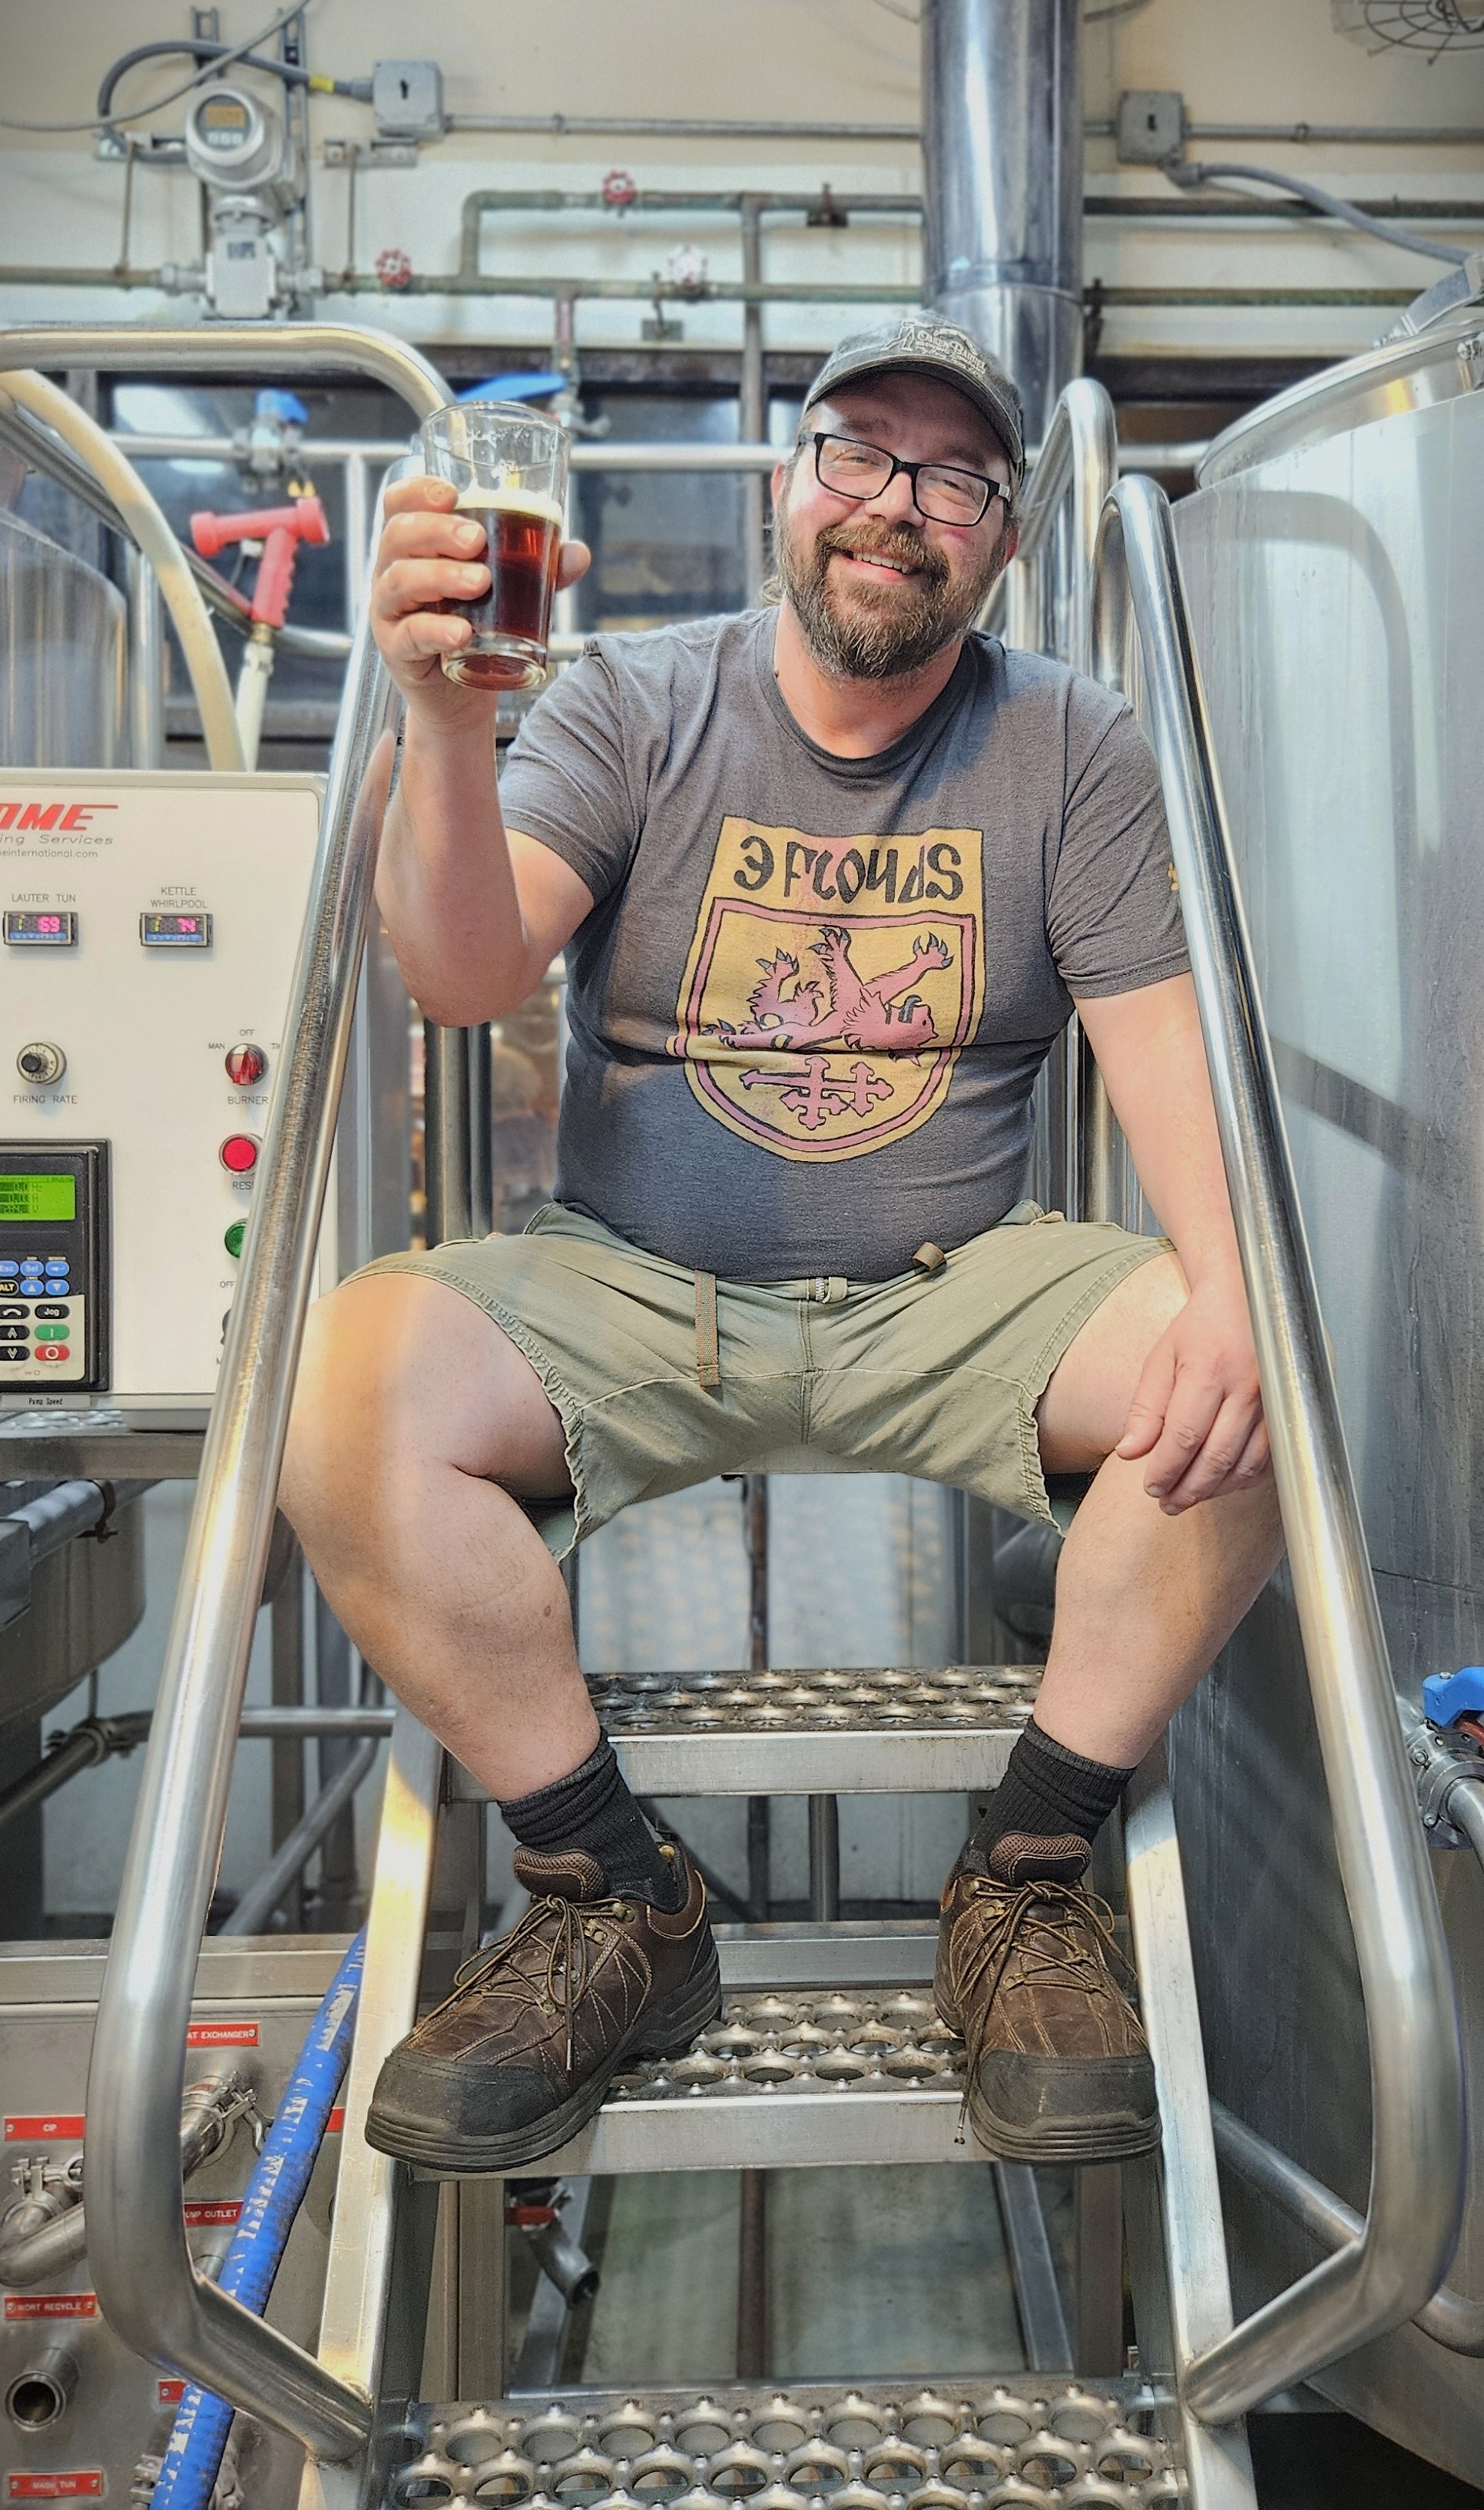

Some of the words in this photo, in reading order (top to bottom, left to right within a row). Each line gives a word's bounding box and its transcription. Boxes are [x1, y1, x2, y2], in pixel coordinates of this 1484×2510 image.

[38, 834, 114, 845] Services
[161, 887, 197, 897] KETTLE
[12, 894, 50, 904] LAUTER
[56, 894, 76, 904] TUN
[151, 899, 208, 909] WHIRLPOOL
[239, 1029, 256, 1037] OFF
[13, 1095, 47, 1104] FIRING
[52, 1095, 78, 1105] RATE
[227, 1096, 270, 1105] BURNER
[25, 1264, 39, 1273] Sel
[0, 1283, 15, 1292] ALT
[44, 1308, 60, 1317] Jog
[46, 1398, 63, 1406] Speed
[201, 2030, 249, 2040] EXCHANGER
[42, 2123, 58, 2132] CIP
[204, 2209, 238, 2219] OUTLET
[44, 2302, 82, 2311] RECYCLE
[60, 2480, 77, 2488] TUN
